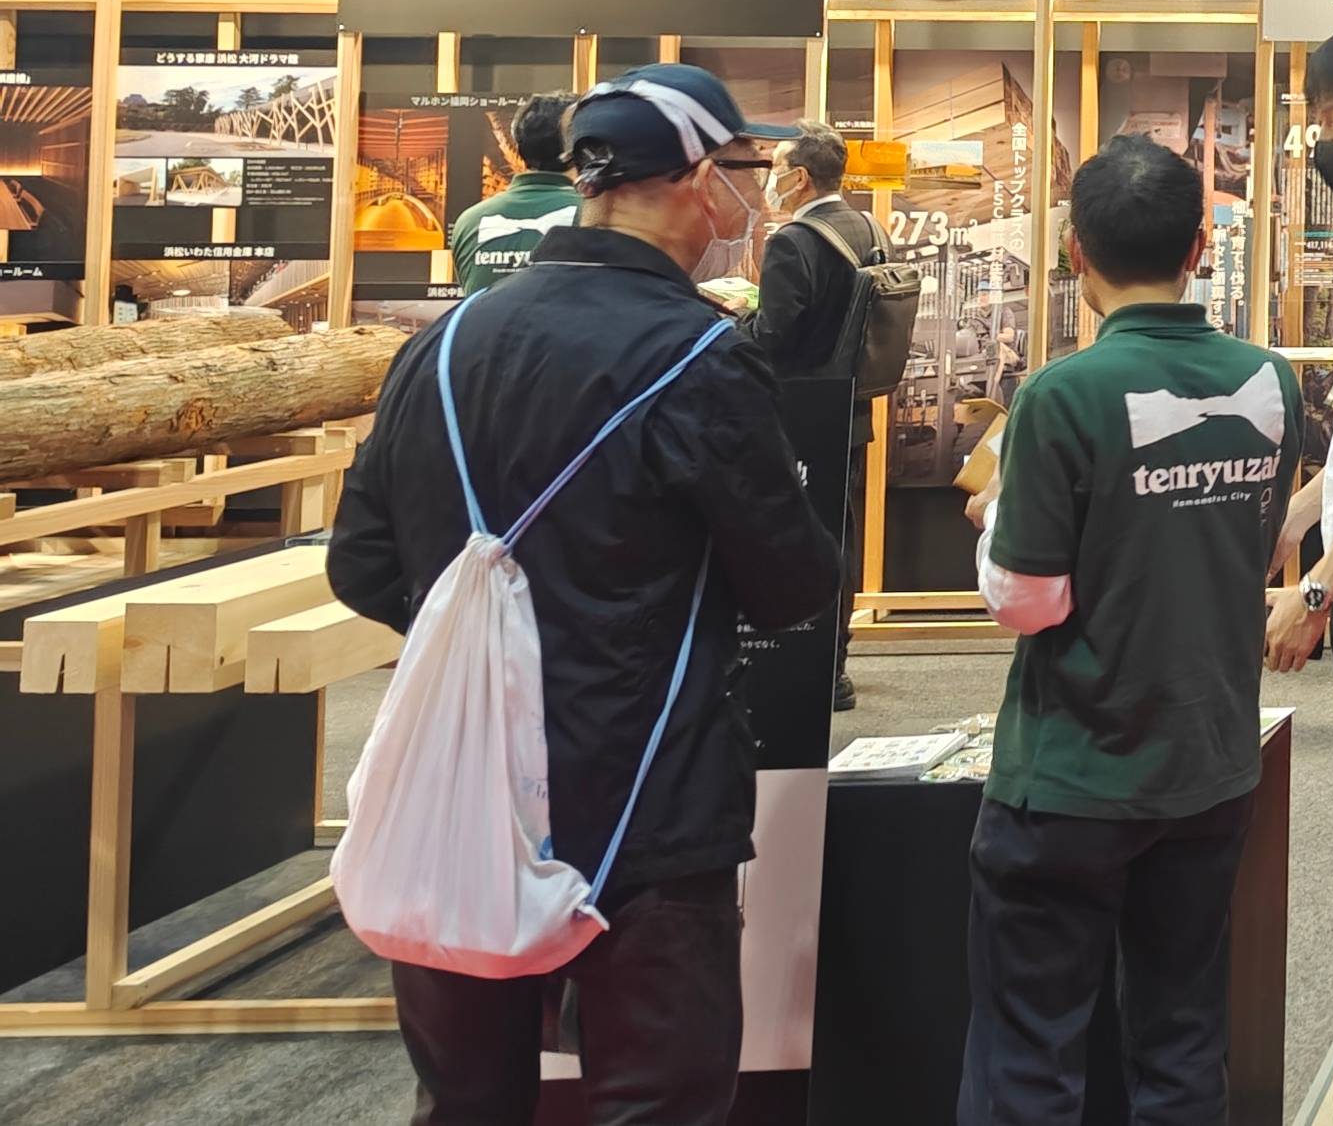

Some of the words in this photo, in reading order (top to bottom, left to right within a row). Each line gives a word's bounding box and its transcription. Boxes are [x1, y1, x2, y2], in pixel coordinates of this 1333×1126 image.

[1008, 122, 1028, 251] 全国トップクラスの
[163, 246, 253, 258] 浜松いわた信用金庫
[254, 246, 275, 258] 本店
[1133, 449, 1281, 496] tenryuzai
[1231, 491, 1252, 502] City
